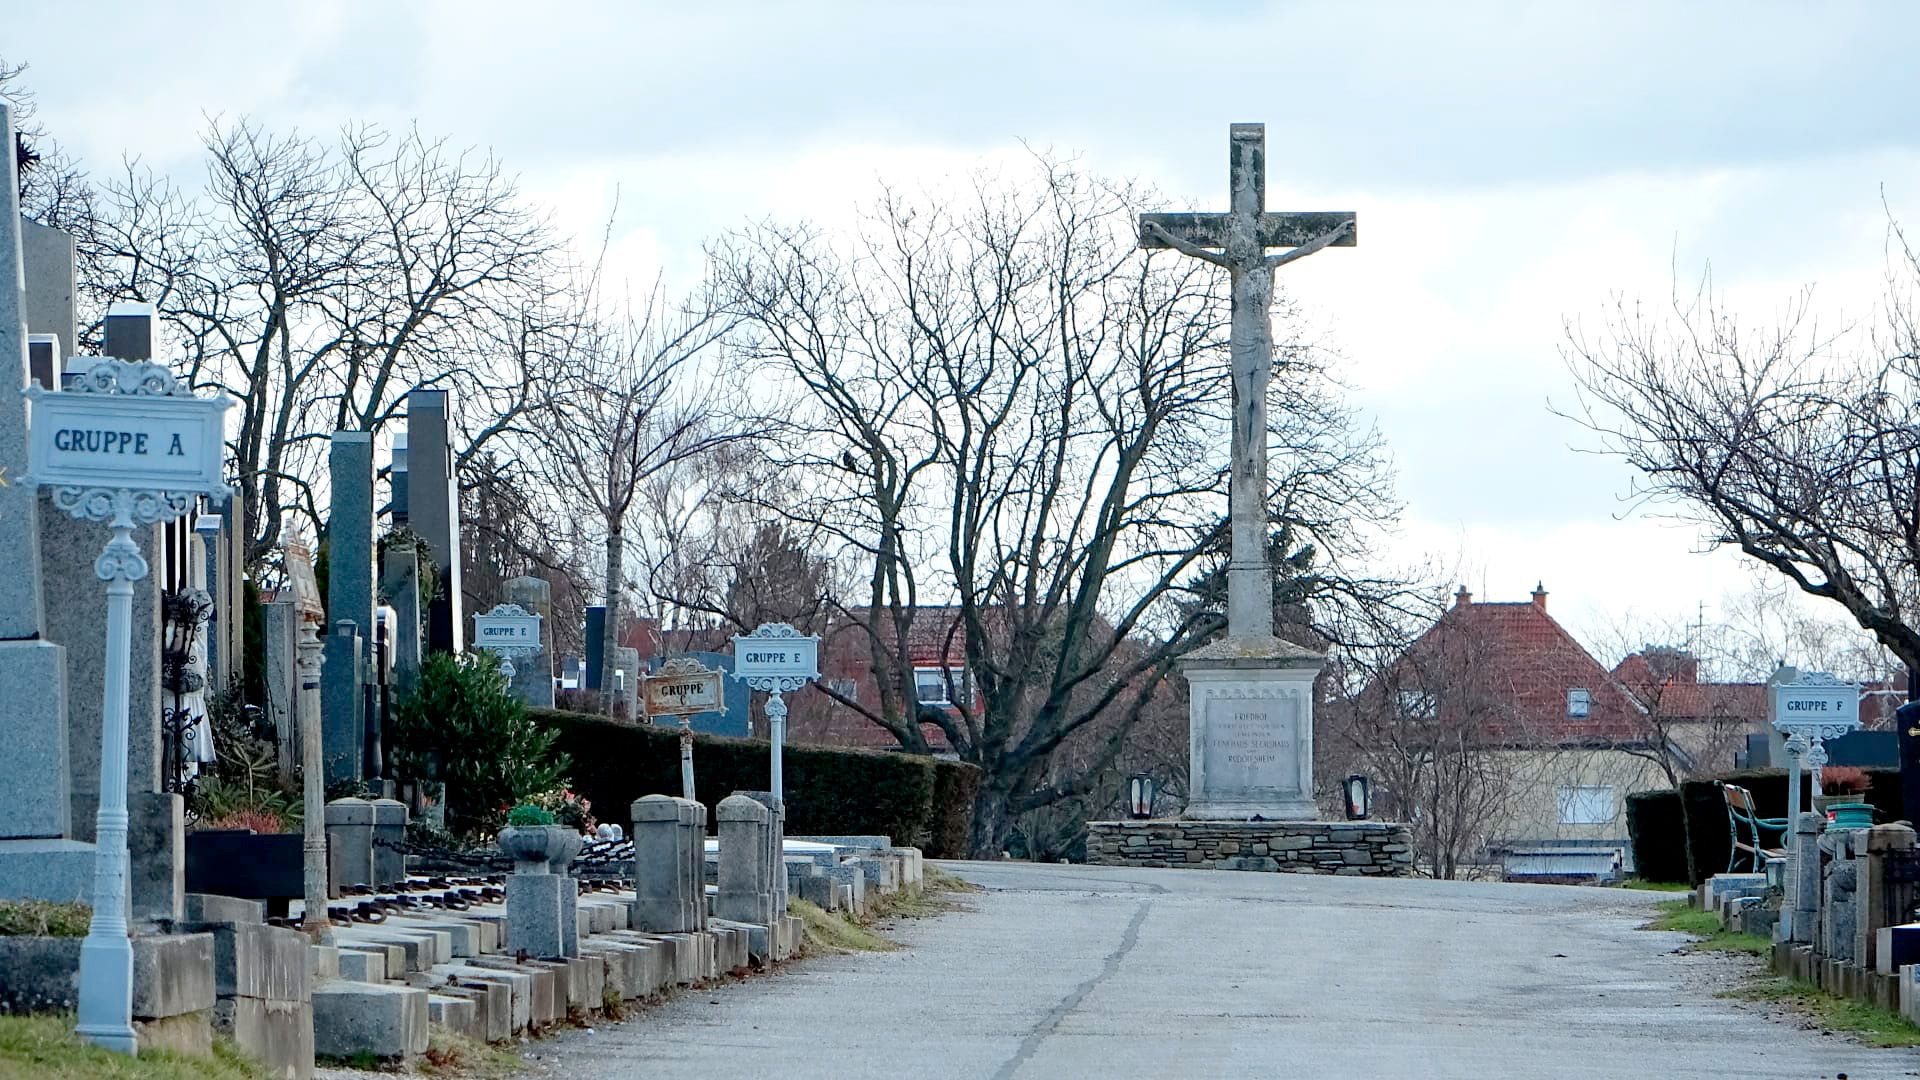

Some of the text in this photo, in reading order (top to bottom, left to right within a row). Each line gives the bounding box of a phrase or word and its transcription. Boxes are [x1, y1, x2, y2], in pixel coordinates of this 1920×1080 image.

[54, 428, 185, 456] GRUPPE A
[483, 627, 527, 636] GRUPPE E
[745, 652, 801, 664] GRUPPE E
[661, 682, 704, 697] GRUPPE
[1787, 700, 1843, 711] GRUPPE F
